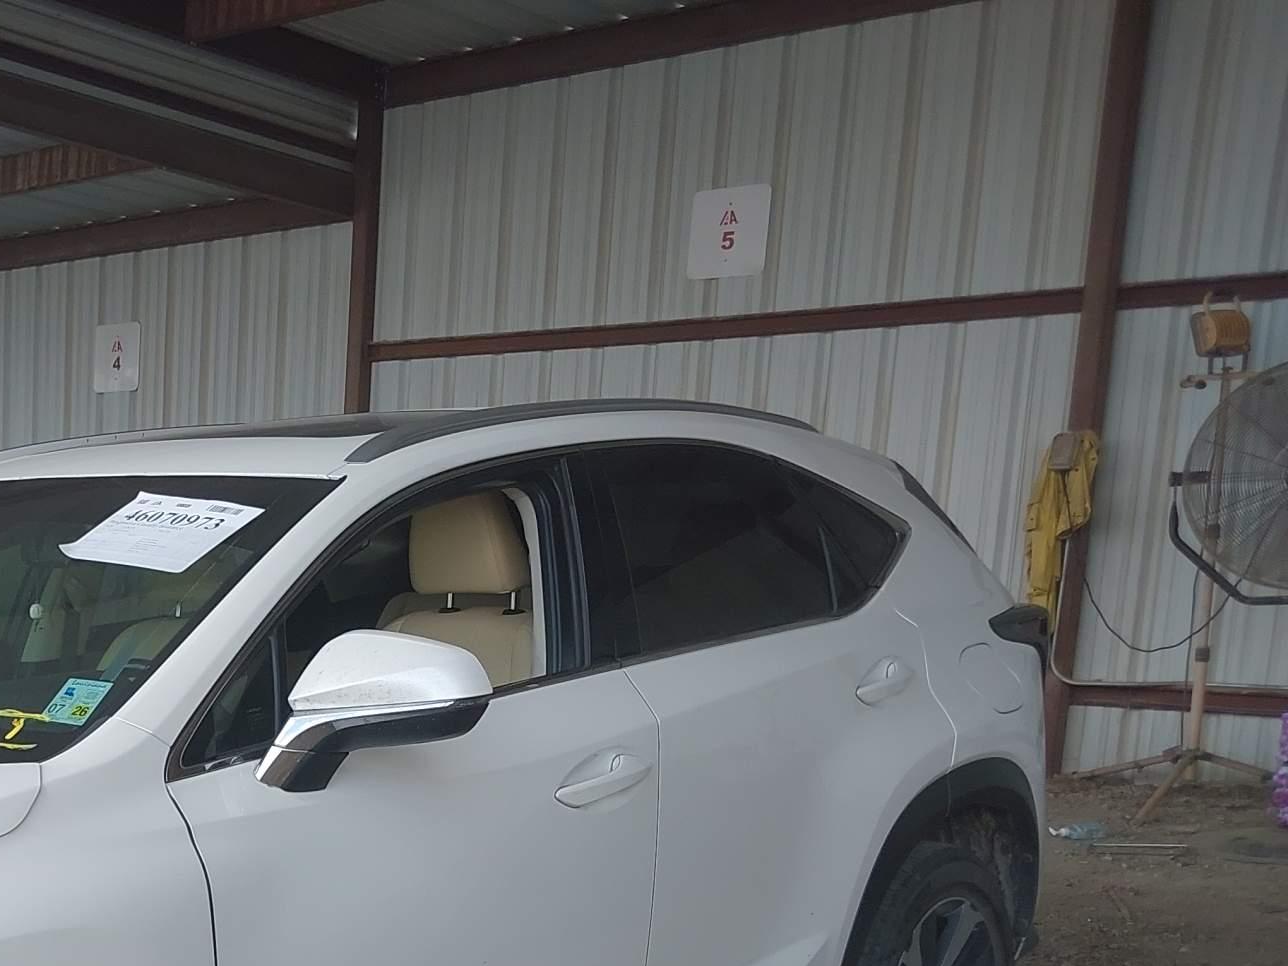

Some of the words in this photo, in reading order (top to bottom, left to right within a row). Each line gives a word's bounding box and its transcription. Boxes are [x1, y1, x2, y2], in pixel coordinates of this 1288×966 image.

[721, 231, 735, 250] 5
[112, 356, 121, 371] 4
[125, 510, 225, 530] 46070973
[48, 703, 66, 714] 07
[72, 705, 89, 717] 26
